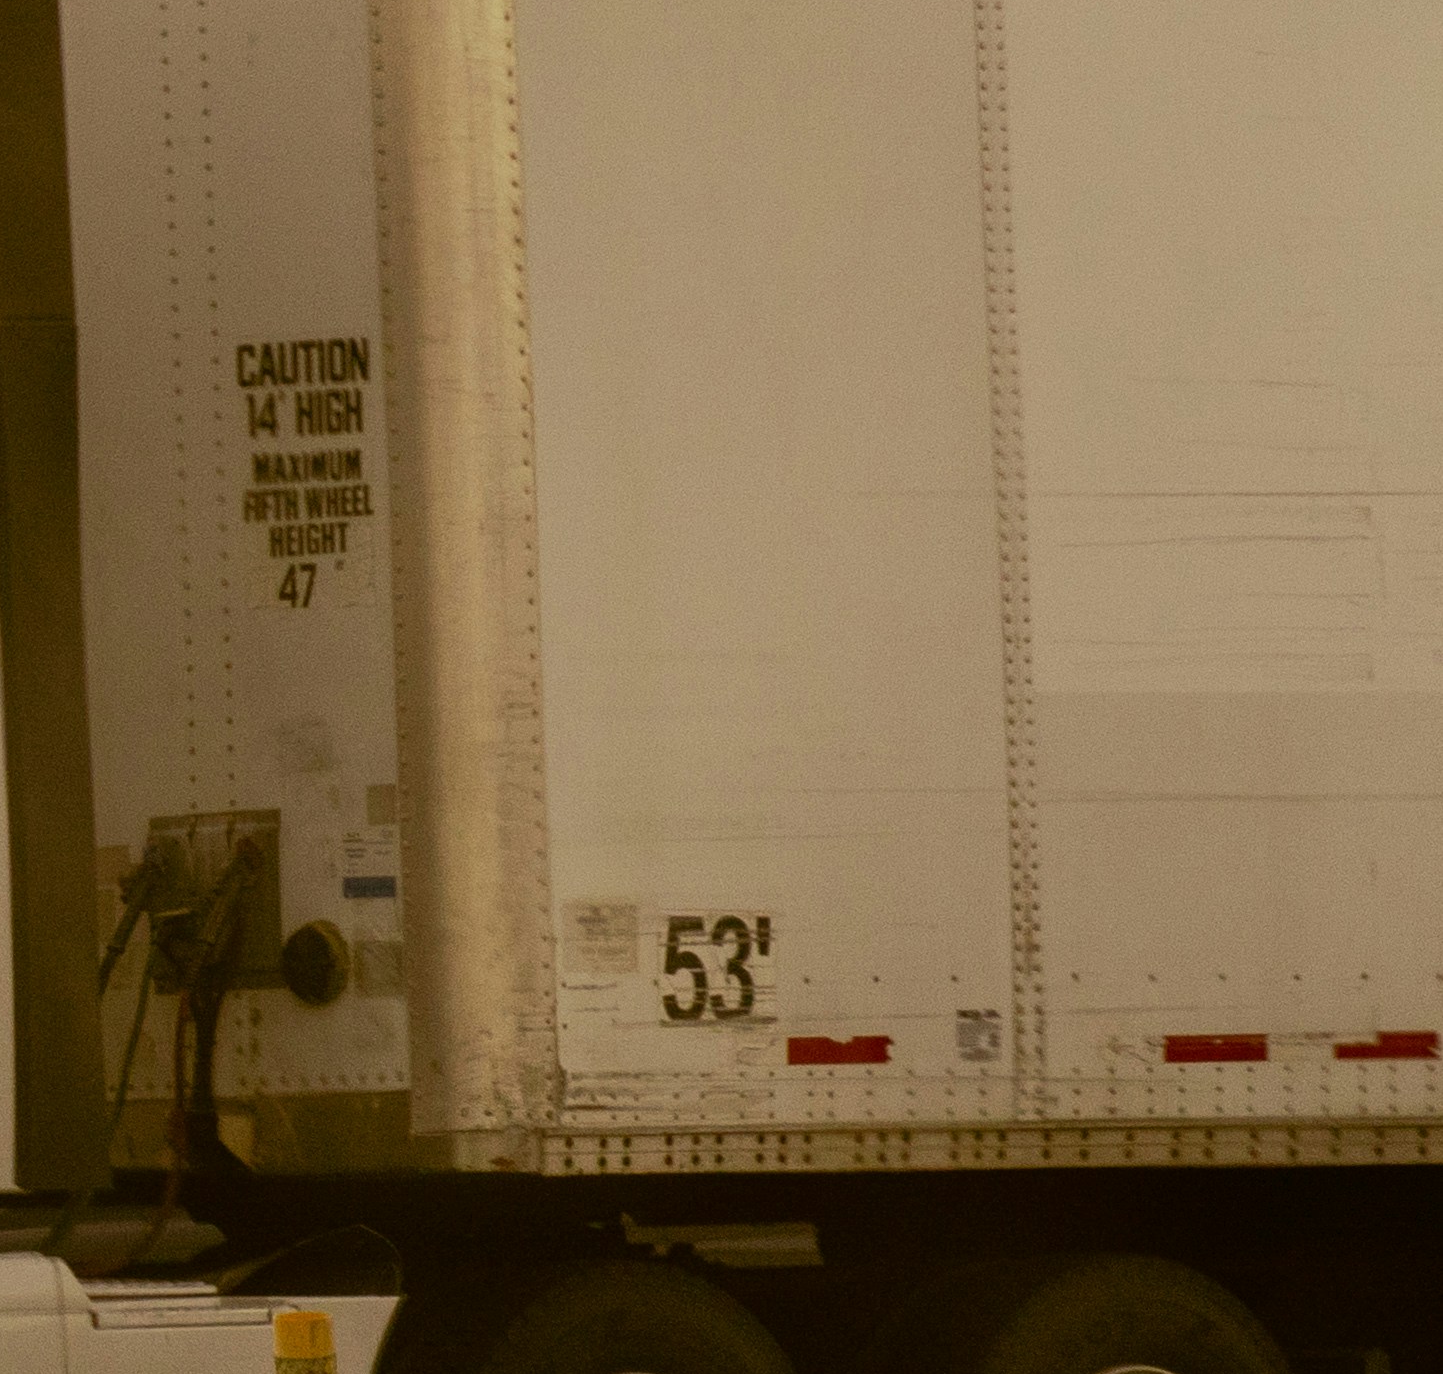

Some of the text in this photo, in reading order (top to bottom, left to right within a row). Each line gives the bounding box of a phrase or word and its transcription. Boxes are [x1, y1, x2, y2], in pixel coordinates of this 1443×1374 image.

[235, 337, 370, 388] CAUTION
[294, 387, 364, 437] HIGH
[251, 447, 363, 484] MAXIMUM
[242, 483, 374, 523] FIFTH WHEEL
[268, 522, 350, 558] HEIGHT
